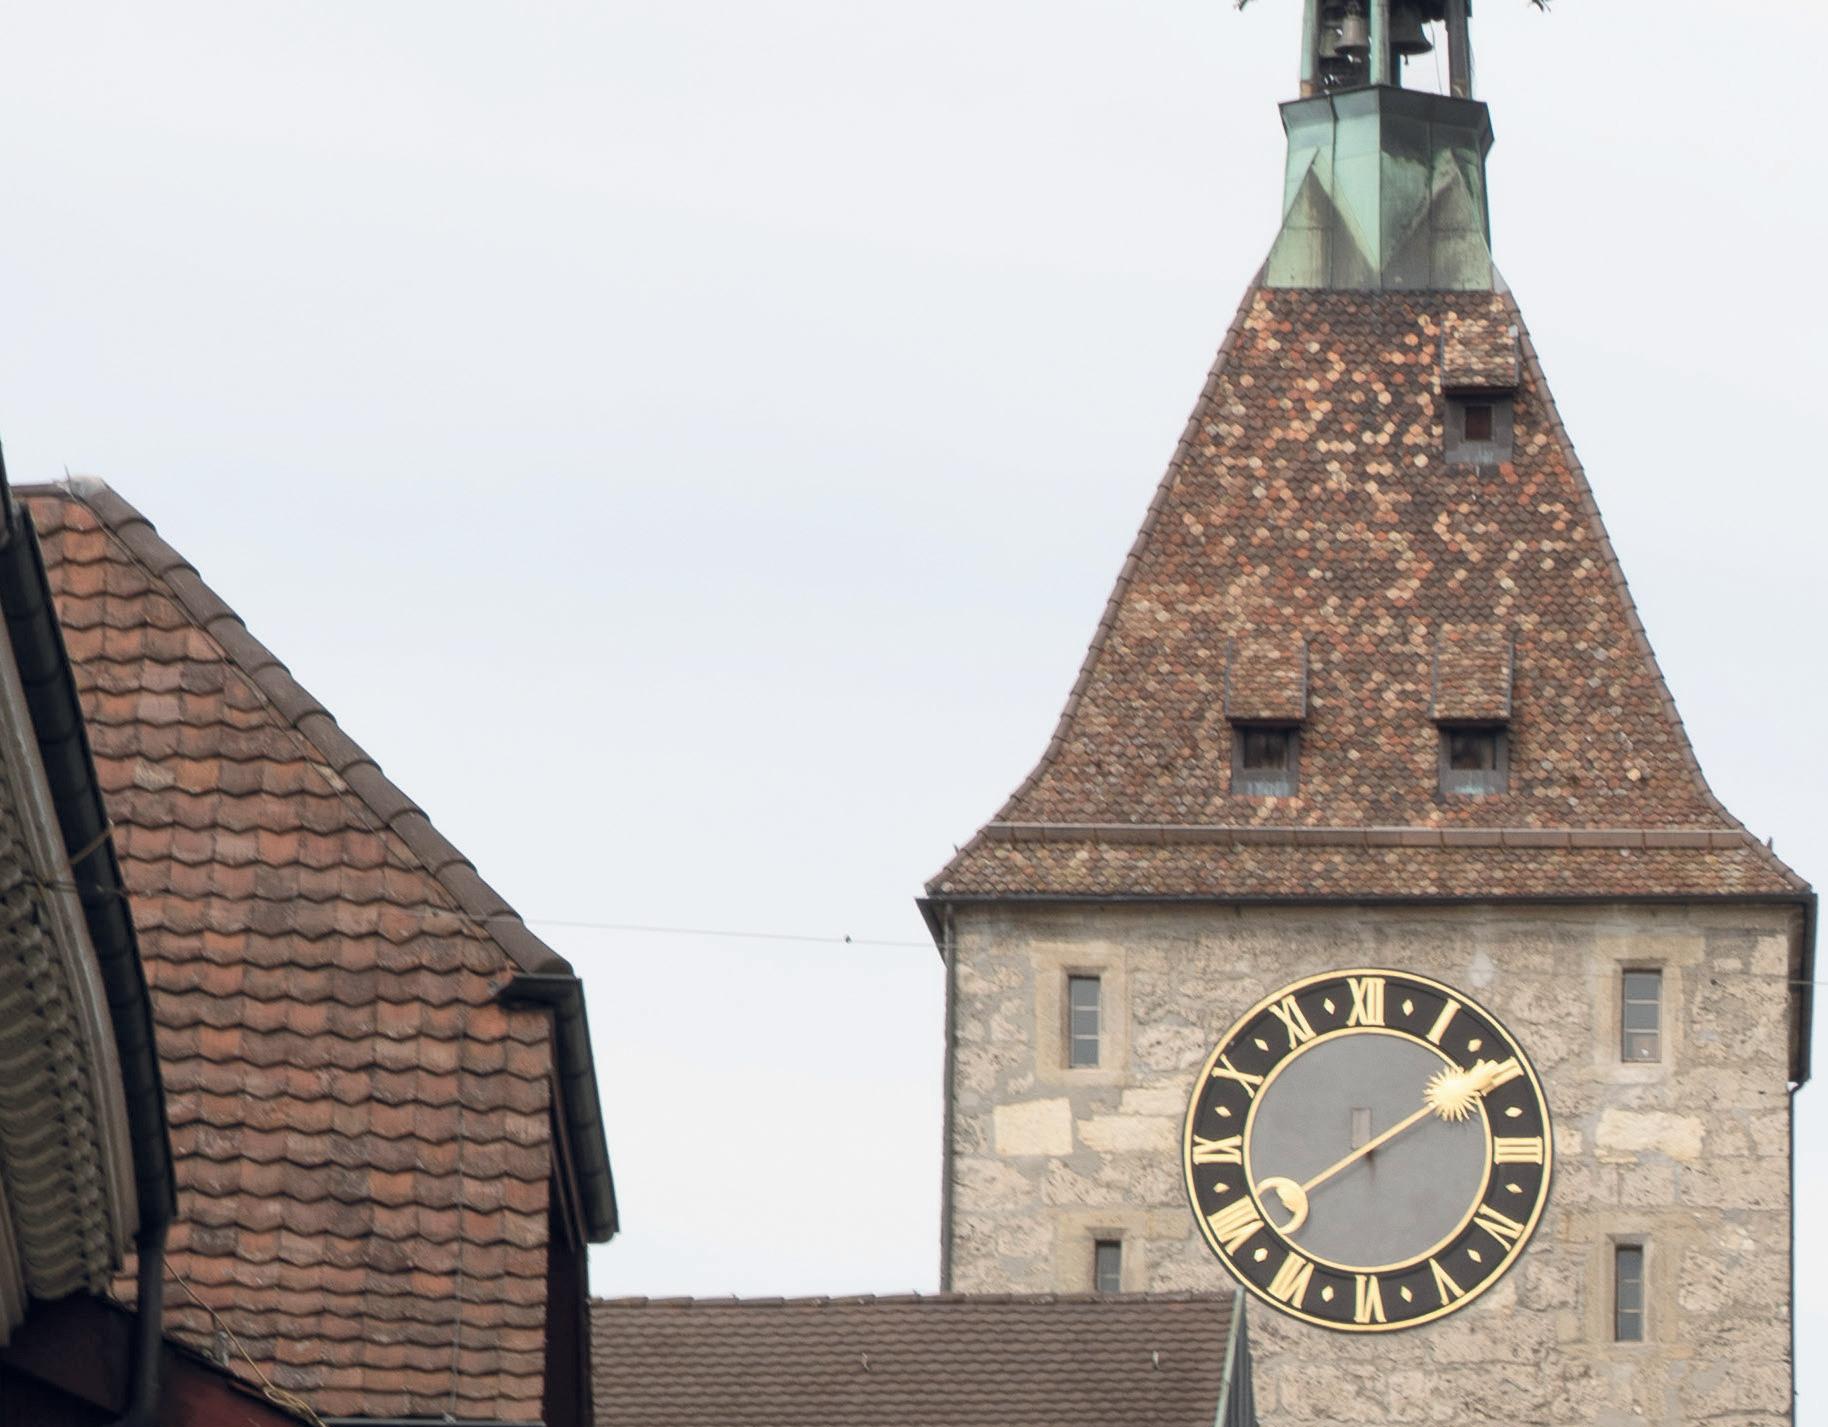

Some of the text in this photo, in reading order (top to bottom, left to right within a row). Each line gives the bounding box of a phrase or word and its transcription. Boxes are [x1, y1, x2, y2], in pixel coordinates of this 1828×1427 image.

[1268, 994, 1317, 1050] XI
[1346, 977, 1386, 1026] XII
[1425, 998, 1462, 1046] I
[1211, 1054, 1265, 1099] X
[1193, 1134, 1242, 1165] IX
[1494, 1136, 1543, 1165] III
[1207, 1195, 1264, 1256] VIII
[1473, 1203, 1525, 1251] IV
[1267, 1252, 1314, 1309] VII
[1354, 1275, 1387, 1323] VI
[1429, 1258, 1465, 1306] V
